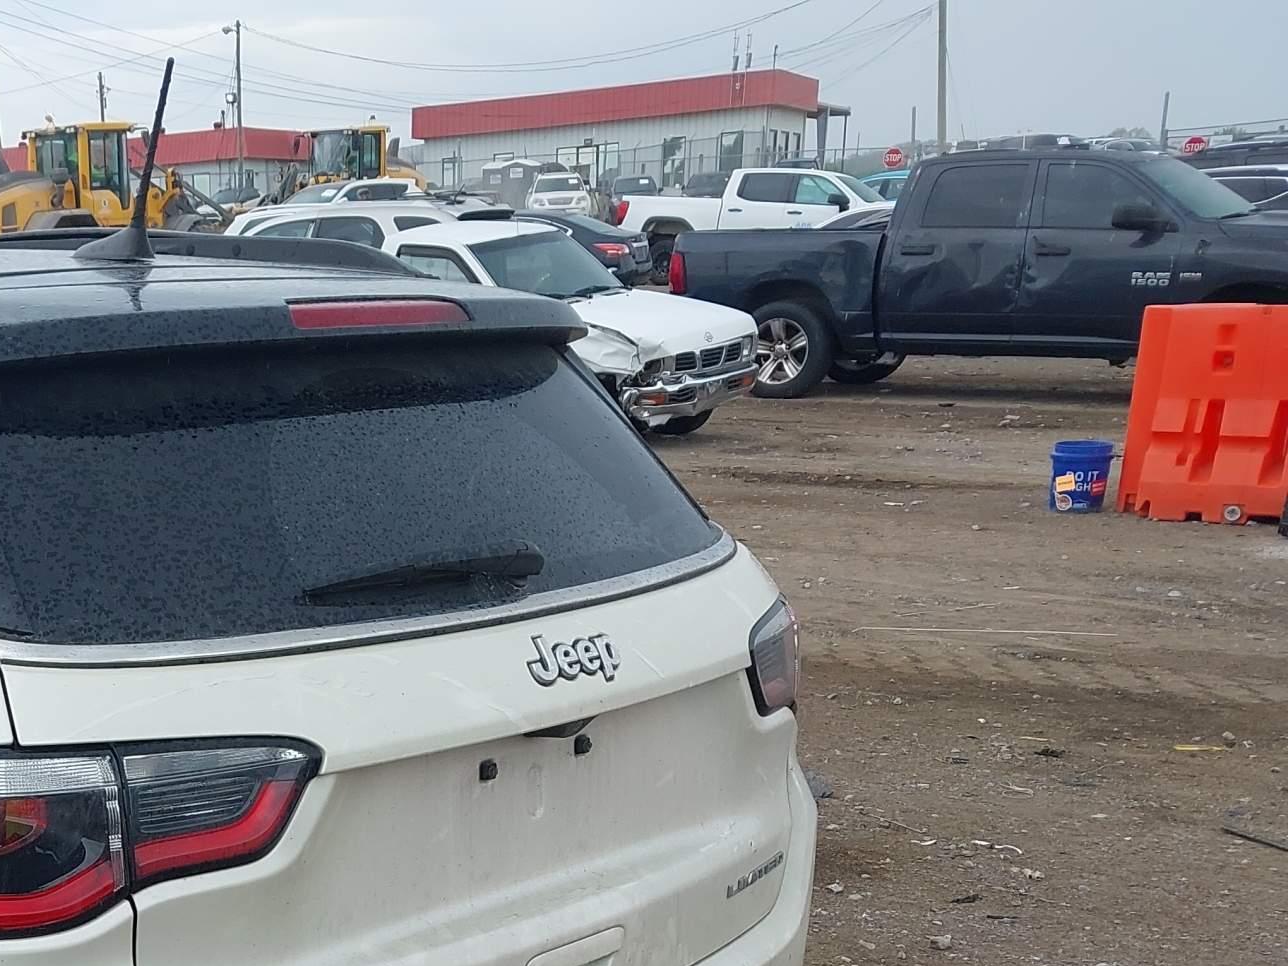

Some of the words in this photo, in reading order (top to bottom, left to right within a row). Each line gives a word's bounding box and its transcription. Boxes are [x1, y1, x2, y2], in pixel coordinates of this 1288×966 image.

[1184, 143, 1206, 152] STOP
[885, 153, 902, 161] STOP
[1088, 471, 1099, 482] IT
[526, 632, 620, 687] Jeep
